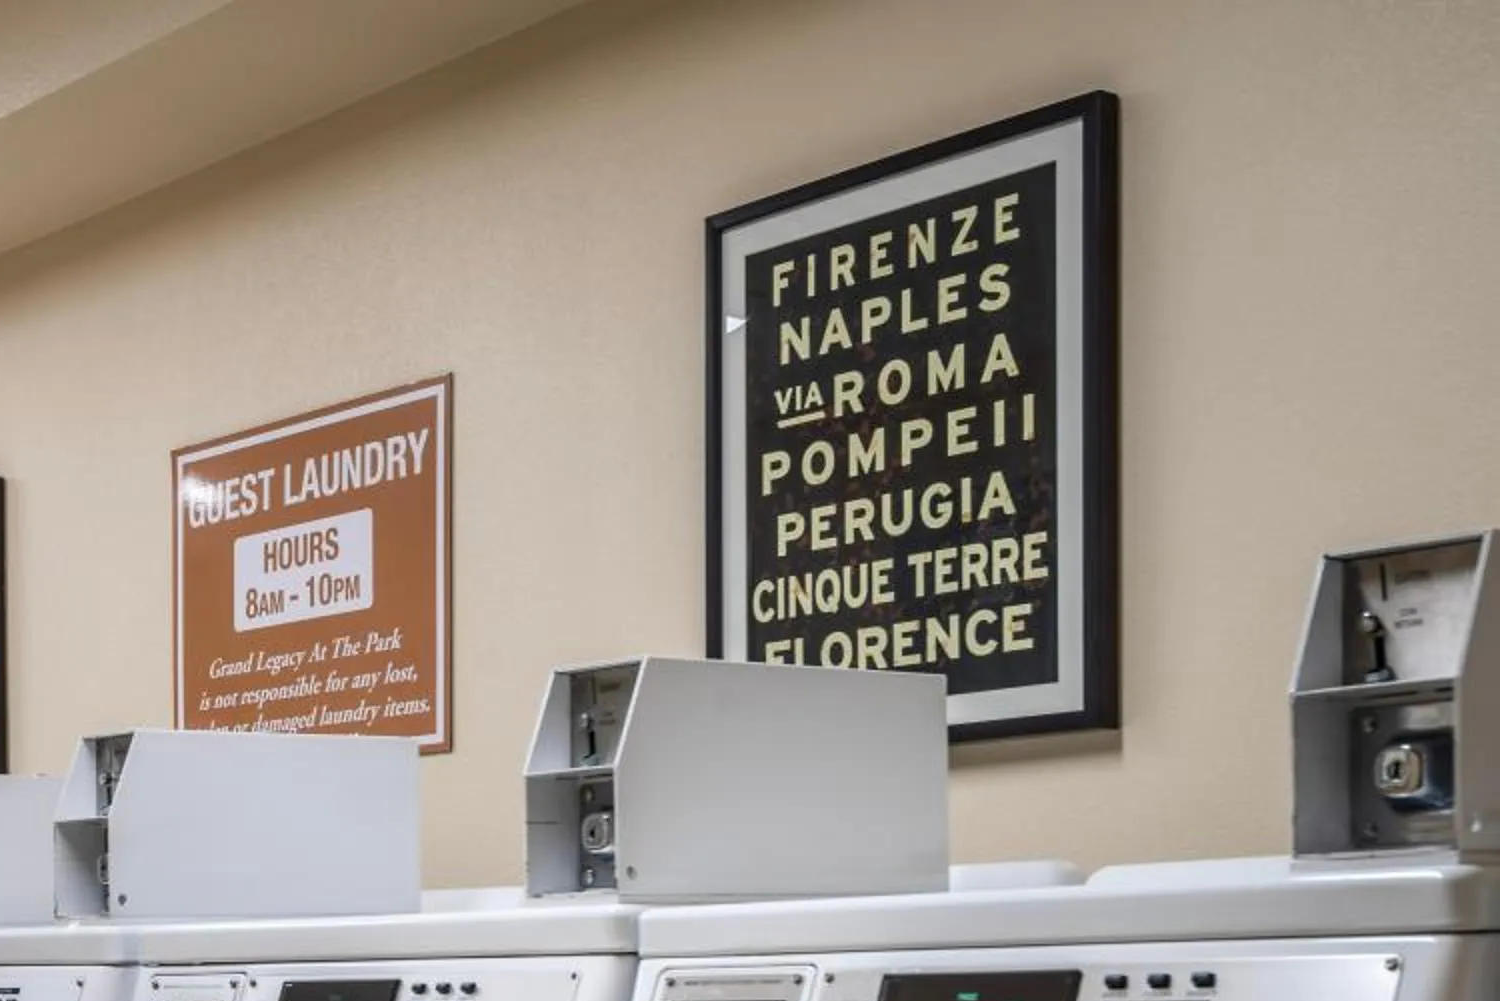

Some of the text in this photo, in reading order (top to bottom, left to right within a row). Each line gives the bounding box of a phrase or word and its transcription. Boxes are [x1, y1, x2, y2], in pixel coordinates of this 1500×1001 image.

[772, 193, 1021, 308] FIRENZE
[779, 263, 1012, 366] NAPLES
[773, 332, 1020, 418] VIA ROMA
[187, 428, 430, 529] GUEST LAUNDRY
[761, 393, 1036, 497] POMPEII
[263, 527, 340, 574] HOURS
[776, 470, 1017, 557] PERUGIA
[245, 587, 285, 619] 8AM
[305, 573, 361, 608] 10PM
[752, 531, 1049, 624] CINQUE TERRE
[199, 691, 211, 711] is
[214, 692, 239, 709] not
[241, 674, 323, 710] responsible
[325, 669, 349, 693] for
[351, 671, 382, 693] any
[209, 627, 403, 679] Grand Legacy At The Park
[319, 699, 381, 727] laundry
